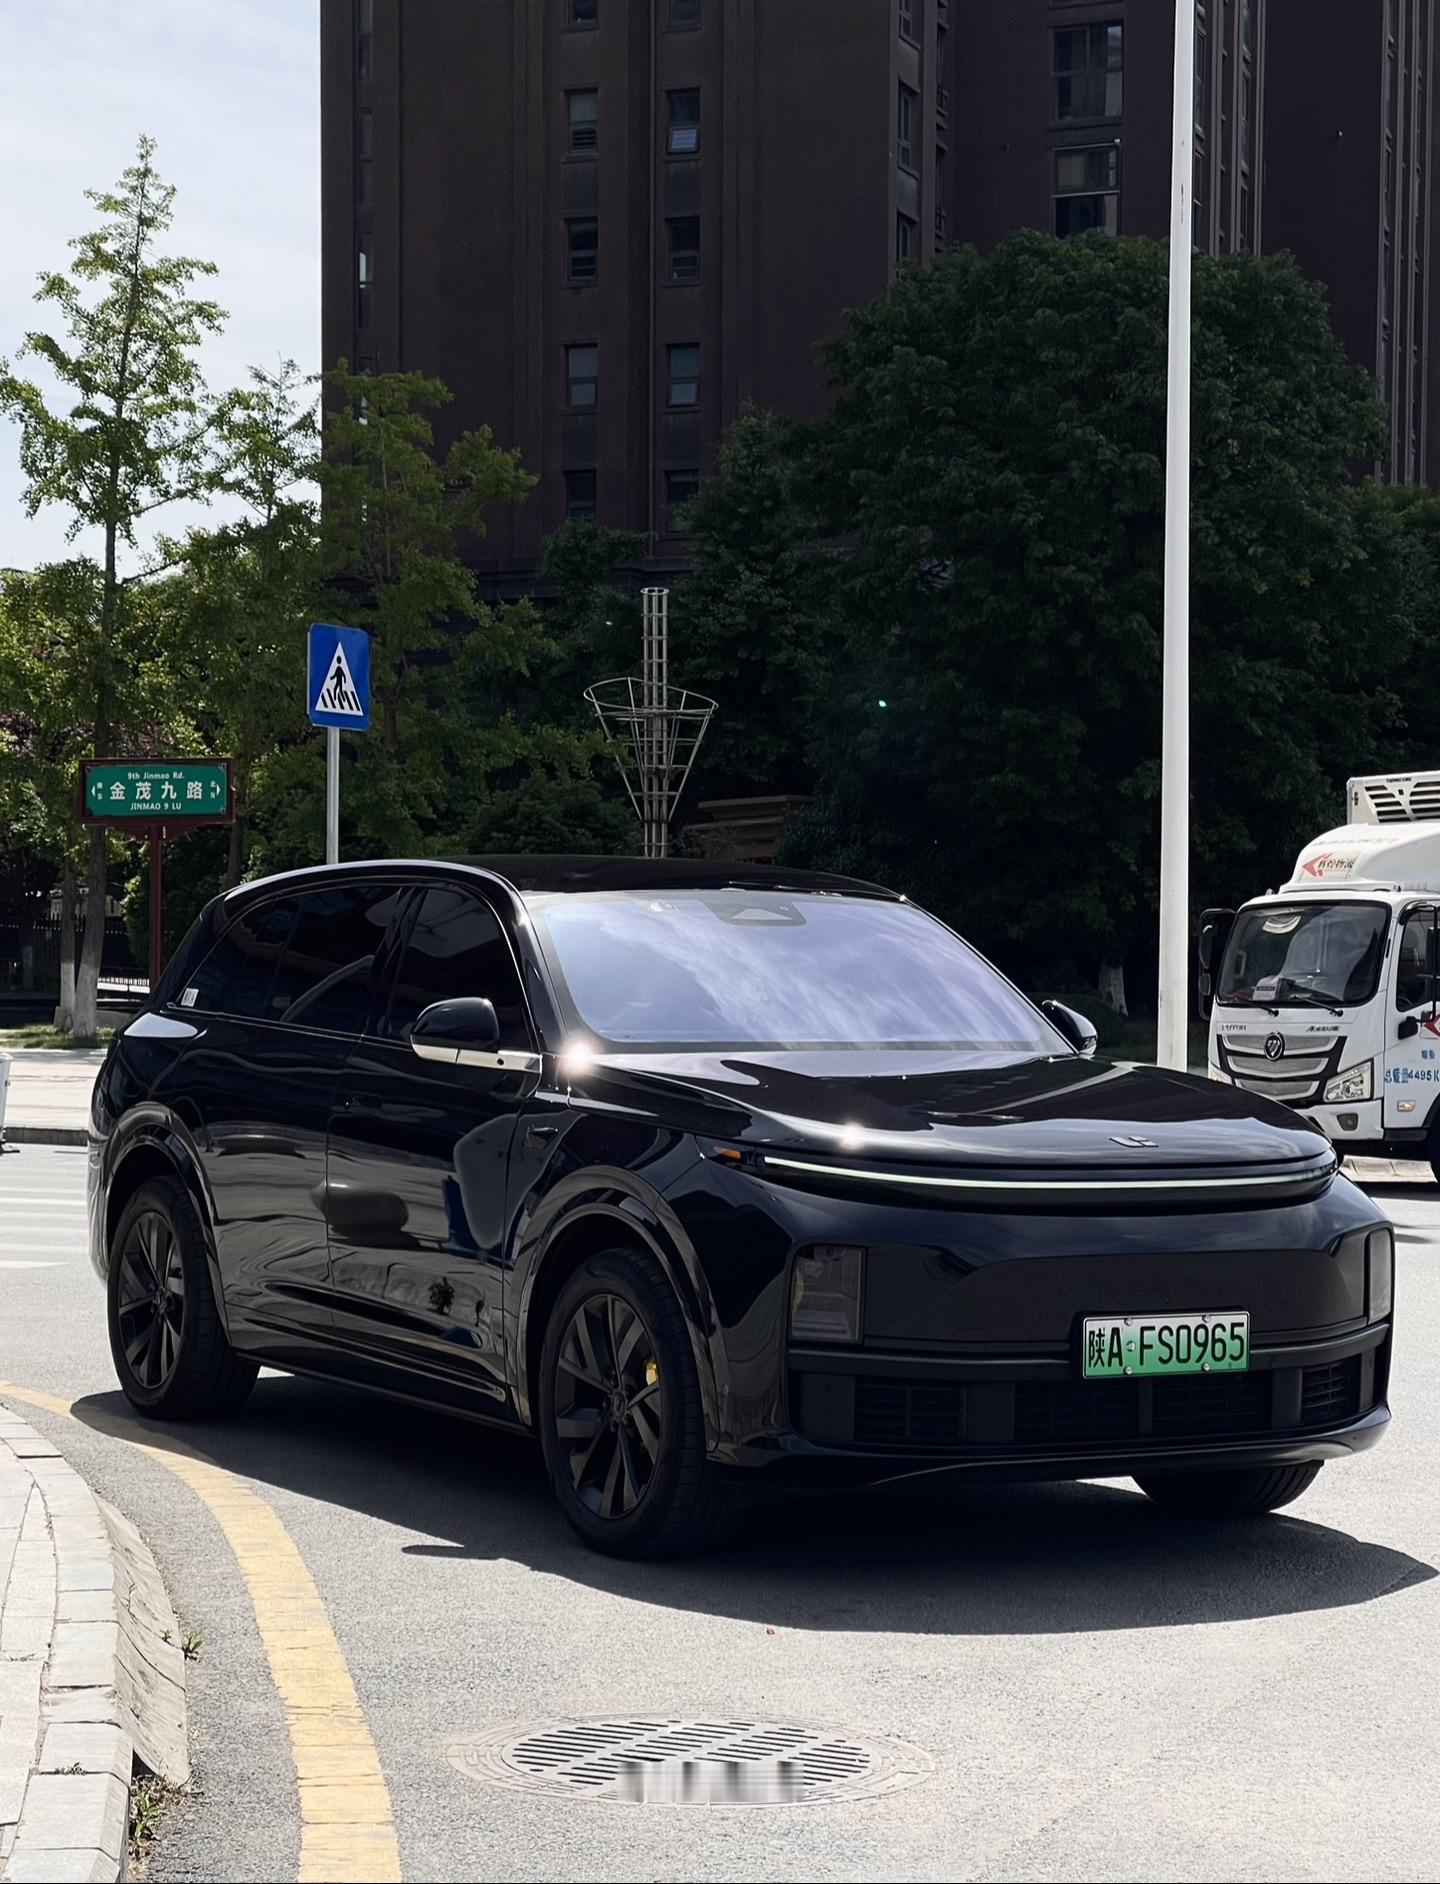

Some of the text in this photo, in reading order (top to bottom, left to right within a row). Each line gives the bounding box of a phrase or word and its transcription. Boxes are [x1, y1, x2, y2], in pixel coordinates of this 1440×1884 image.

[128, 771, 185, 780] 9th Jinmao Rd.
[110, 781, 203, 800] 金茂九路
[130, 802, 182, 810] JINMAO 9 LU
